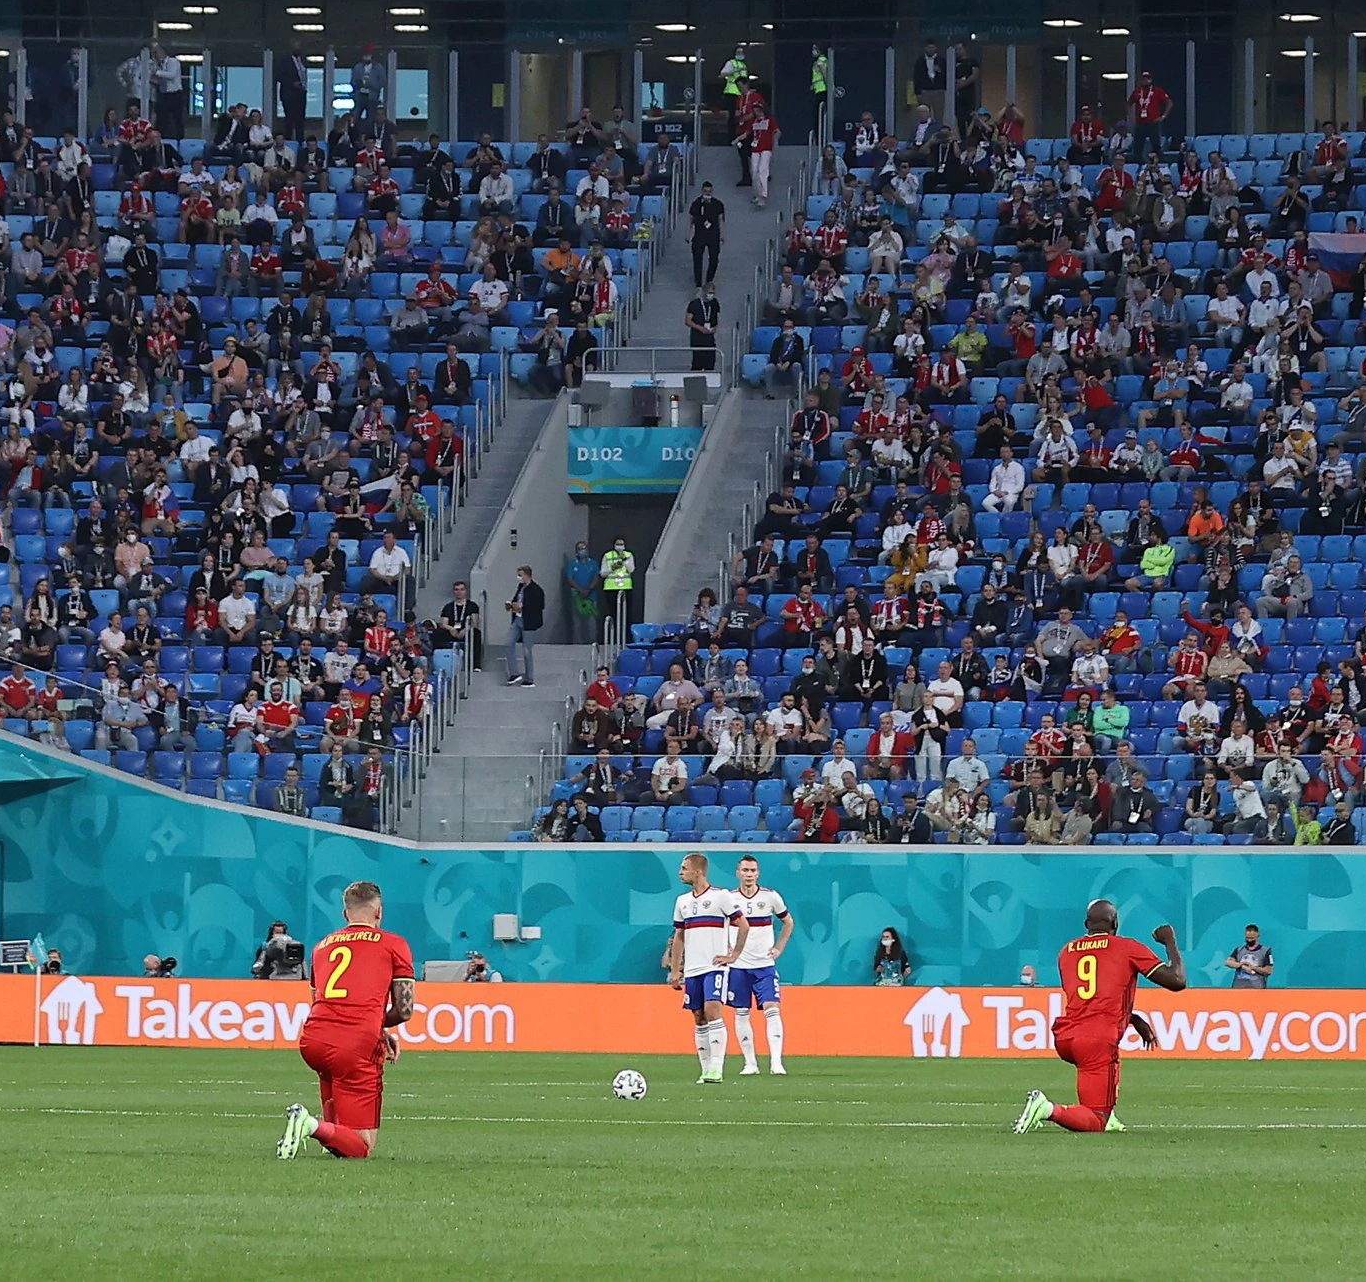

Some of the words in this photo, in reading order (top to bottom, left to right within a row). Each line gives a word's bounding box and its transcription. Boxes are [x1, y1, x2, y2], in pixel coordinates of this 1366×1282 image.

[654, 123, 663, 133] D
[665, 123, 683, 133] 102
[577, 446, 623, 462] D102
[661, 446, 696, 462] D10
[746, 901, 753, 916] 5
[1076, 938, 1109, 951] LUKAKU
[324, 945, 353, 1000] 2
[1077, 954, 1098, 1000] 9
[714, 973, 723, 989] 8
